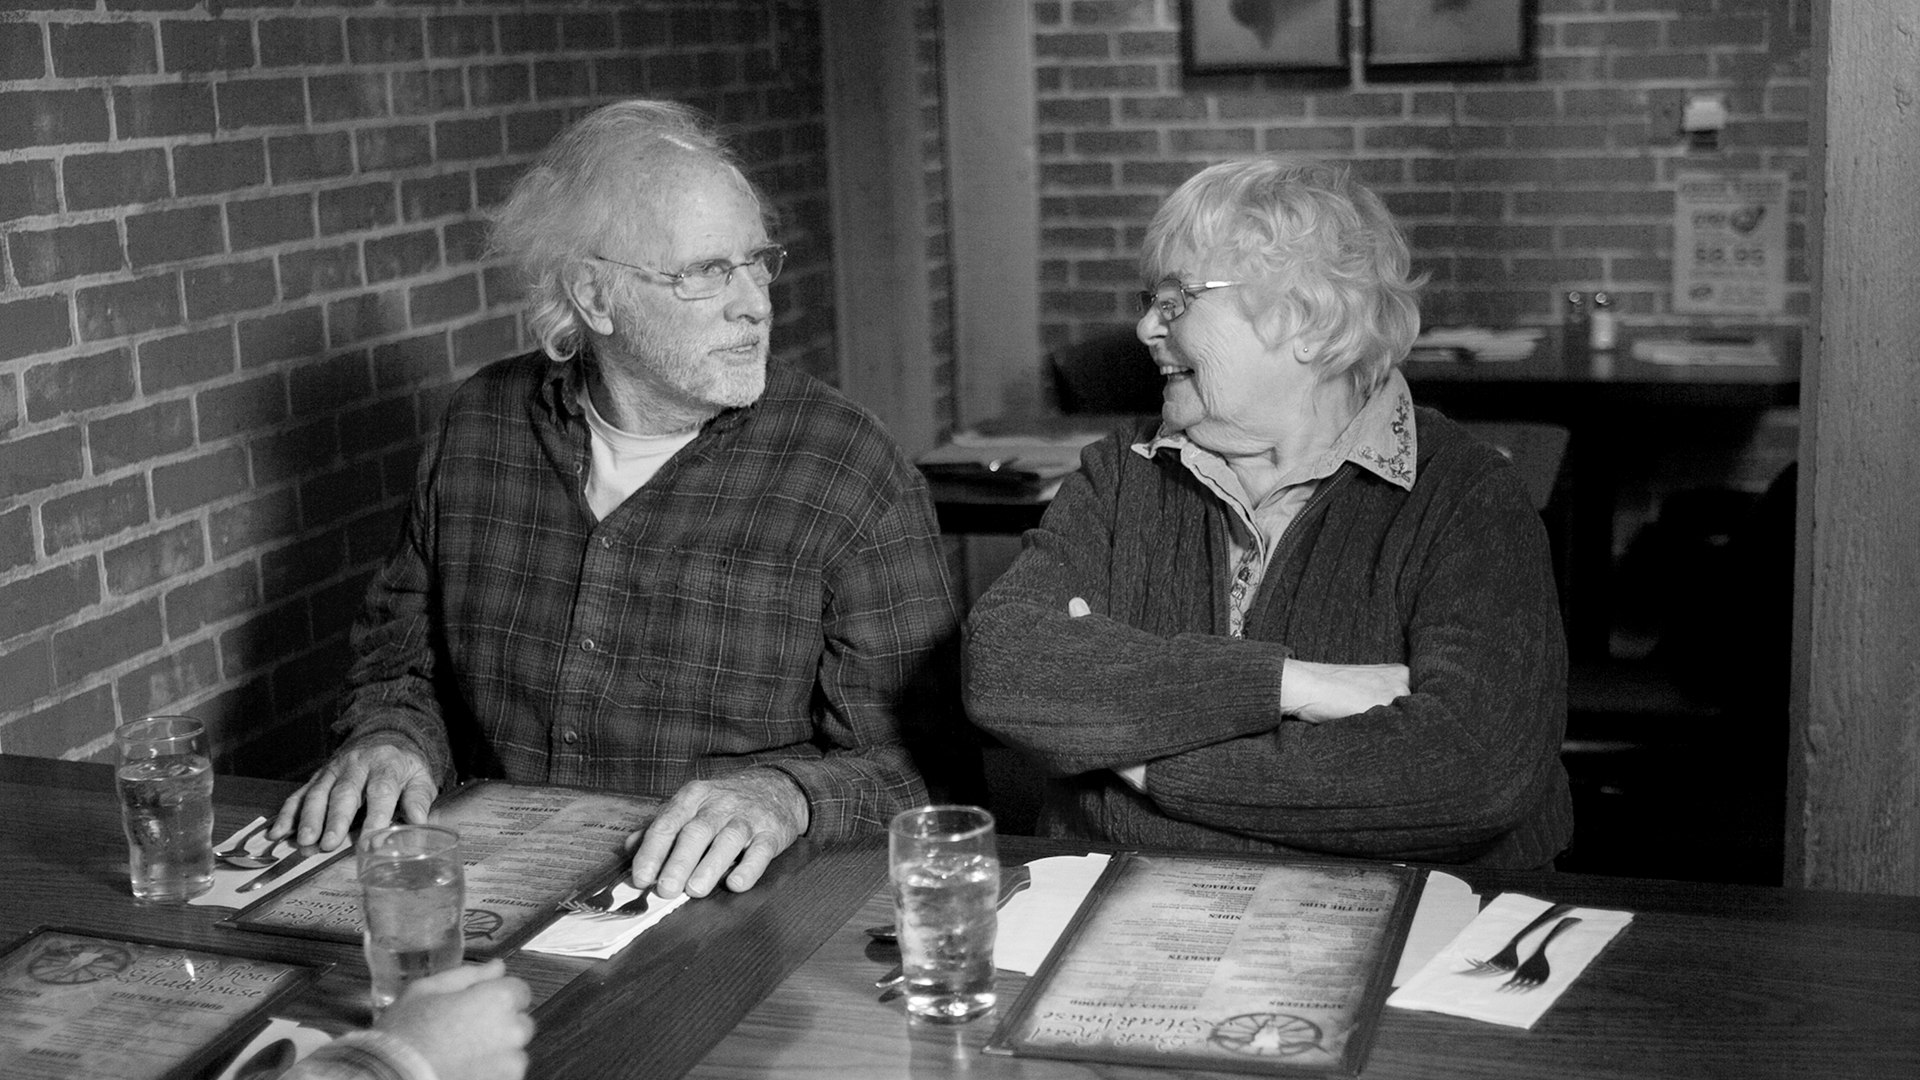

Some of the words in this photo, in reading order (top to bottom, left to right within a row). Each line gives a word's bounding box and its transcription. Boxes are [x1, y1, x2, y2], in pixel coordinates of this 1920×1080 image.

[1191, 883, 1256, 892] BEVERAGES
[282, 899, 358, 917] khouse
[480, 898, 539, 908] APPETIZERS
[1329, 904, 1354, 912] THE
[1356, 905, 1380, 913] FOR
[254, 907, 323, 927] Road
[1208, 912, 1242, 921] SIDES
[1167, 953, 1221, 963] BASKETS
[221, 963, 294, 987] Road
[1069, 999, 1126, 1008] SEAFOOD
[1141, 1003, 1197, 1011] CHICKEN
[1267, 1001, 1345, 1011] APPETIZERS
[1024, 1025, 1103, 1046] Road
[1113, 1032, 1207, 1053] Back
